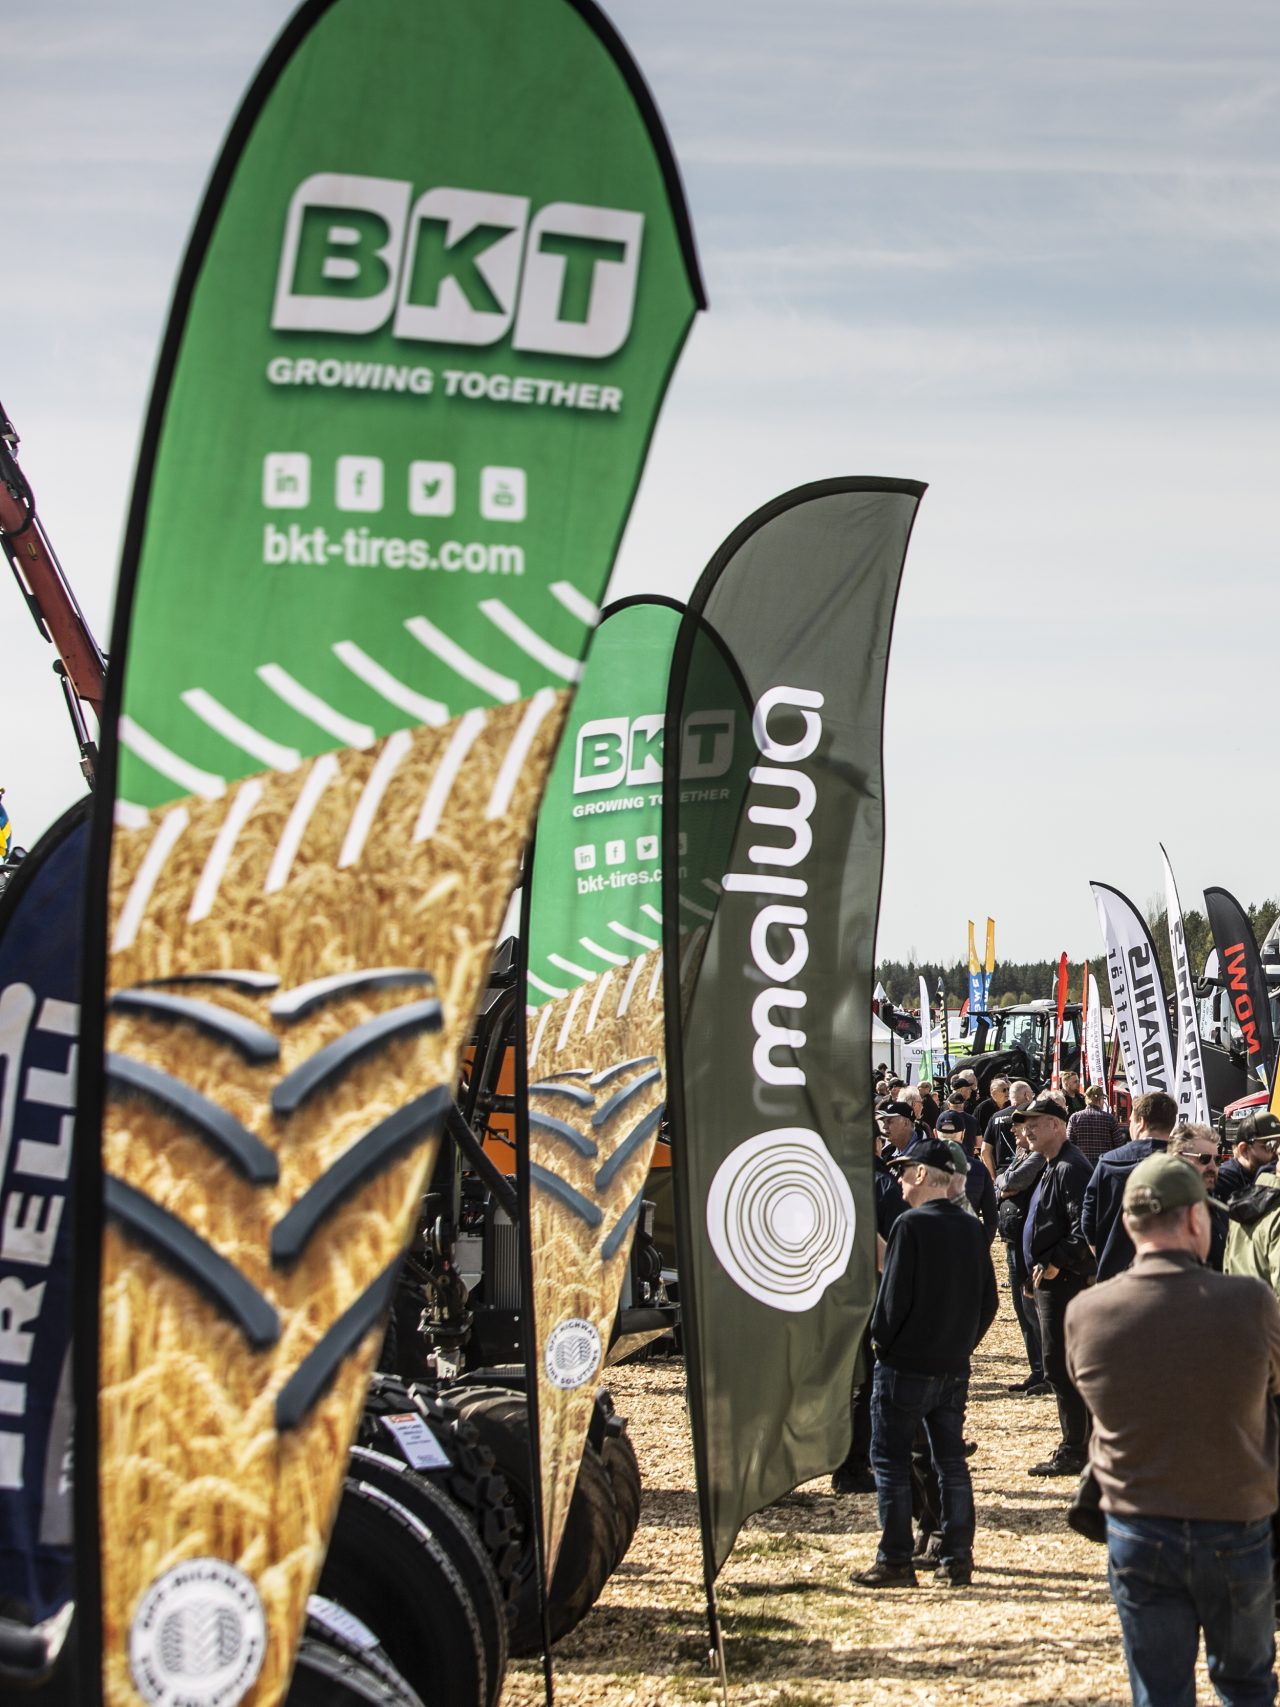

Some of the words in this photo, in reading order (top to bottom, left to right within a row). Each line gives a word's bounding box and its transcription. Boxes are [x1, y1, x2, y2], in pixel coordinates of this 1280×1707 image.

[272, 173, 644, 358] BKT
[267, 357, 433, 394] GROWING
[442, 370, 623, 412] TOGETHER
[262, 523, 525, 576] bkt-tires.com
[572, 796, 645, 818] GROWING
[648, 788, 731, 807] TETHER
[577, 867, 688, 895] bkt-tires.cm
[721, 685, 825, 1086] malwa
